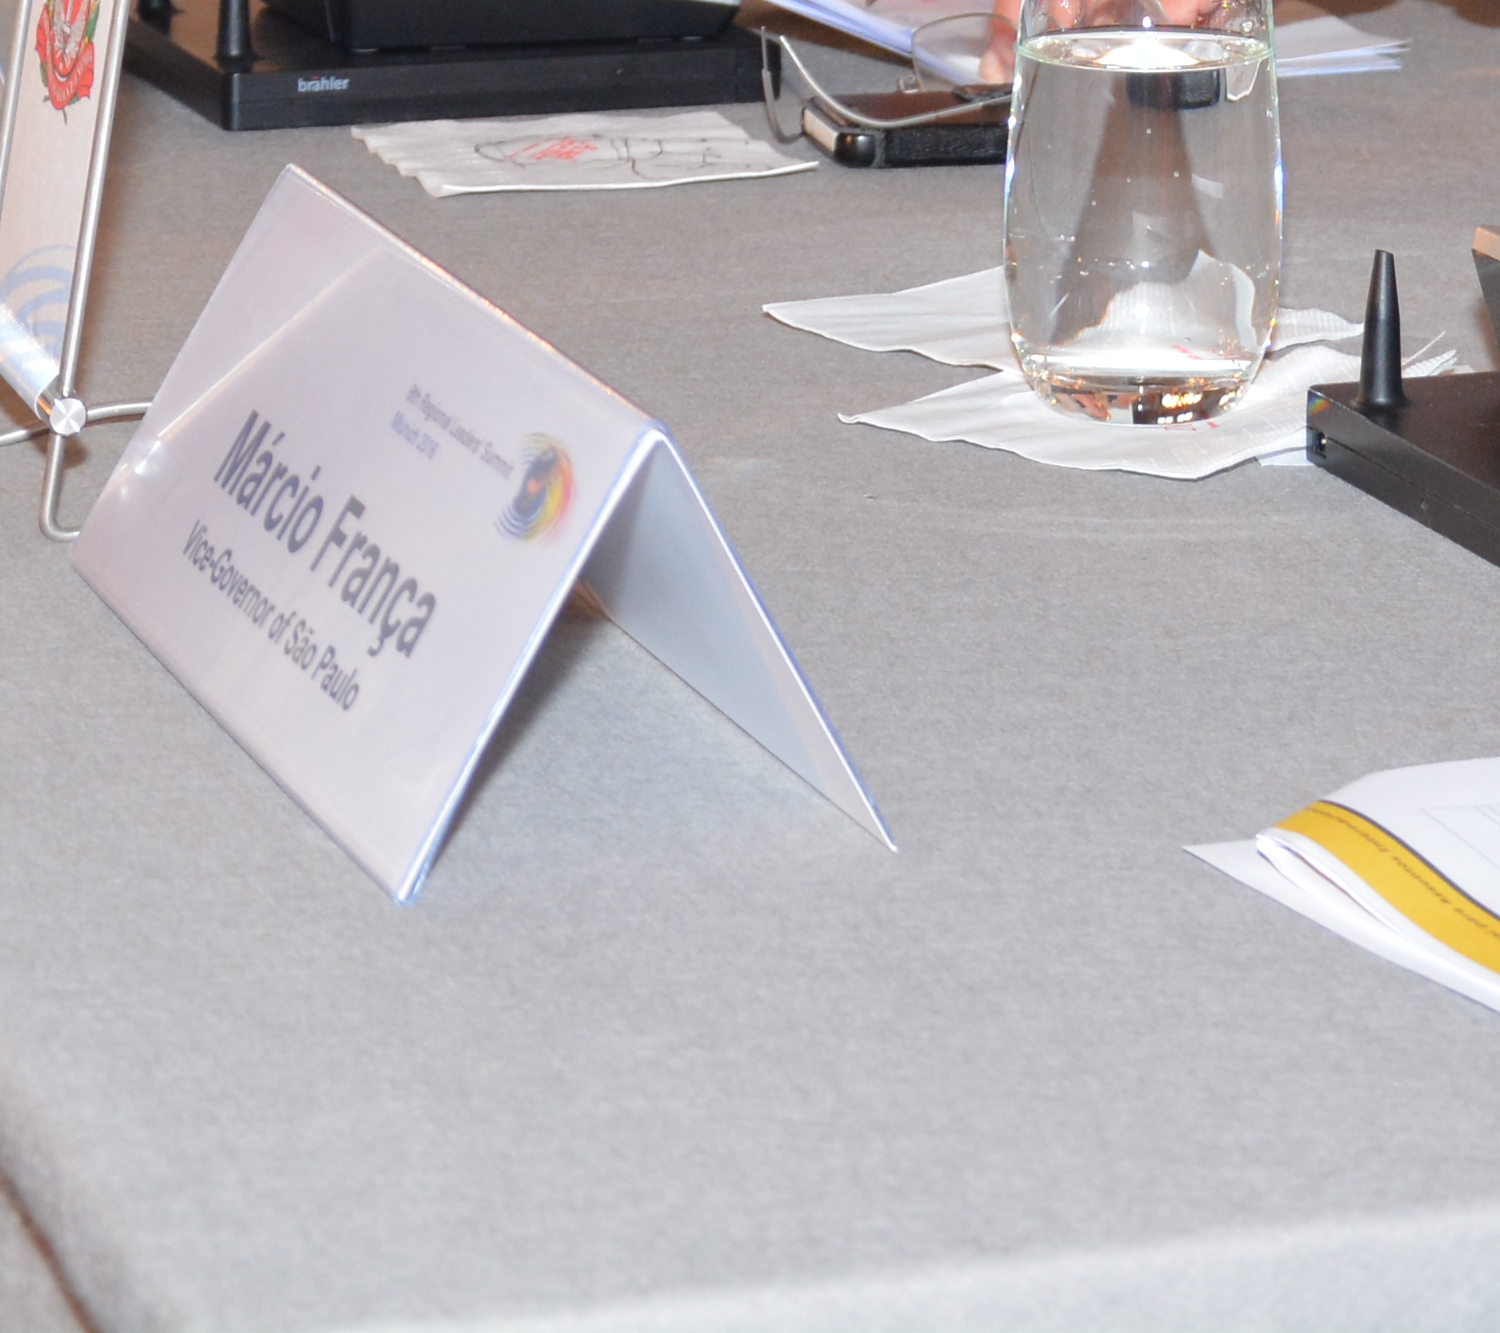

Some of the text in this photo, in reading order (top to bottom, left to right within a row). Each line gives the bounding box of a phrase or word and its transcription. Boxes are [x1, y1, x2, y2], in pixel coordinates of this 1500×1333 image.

[182, 519, 361, 711] Vice-Governor of São Paulo
[213, 409, 437, 659] Márcio França
